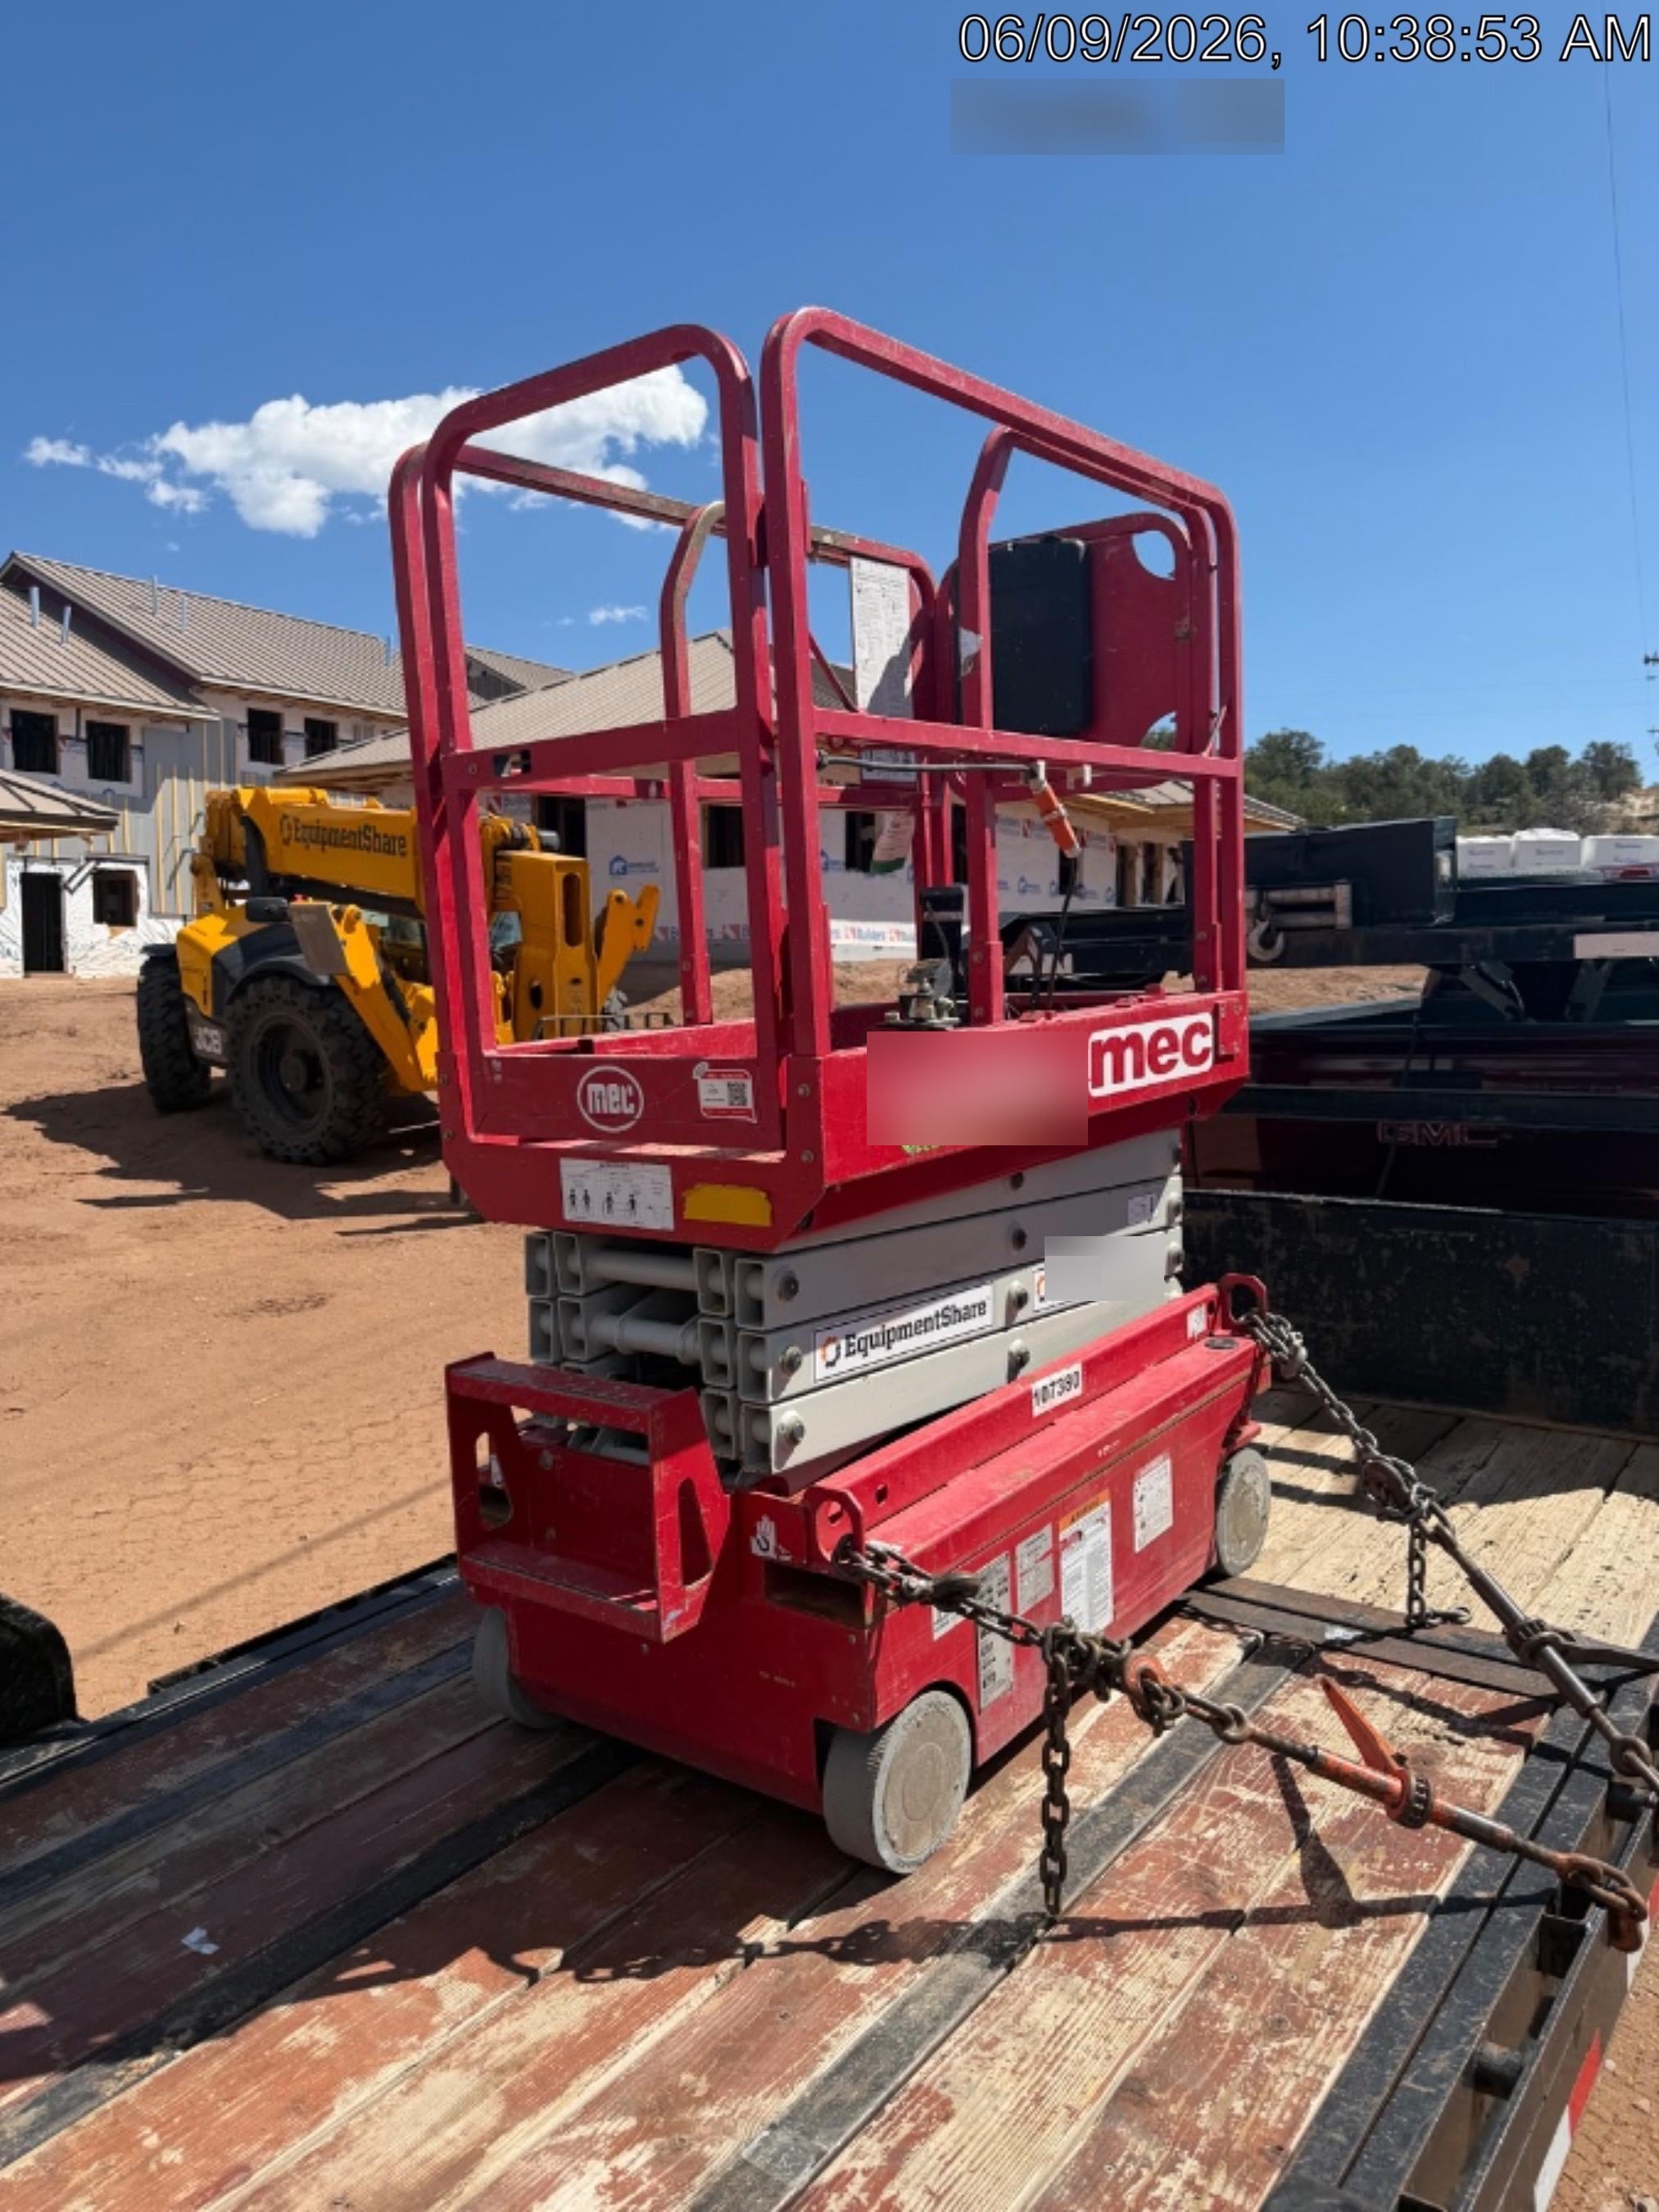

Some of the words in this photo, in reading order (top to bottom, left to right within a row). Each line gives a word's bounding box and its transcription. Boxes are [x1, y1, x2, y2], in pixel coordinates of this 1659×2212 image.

[292, 816, 407, 857] EquipmentShare
[1091, 1022, 1212, 1090] mec
[844, 1299, 986, 1358] EquipmentShare
